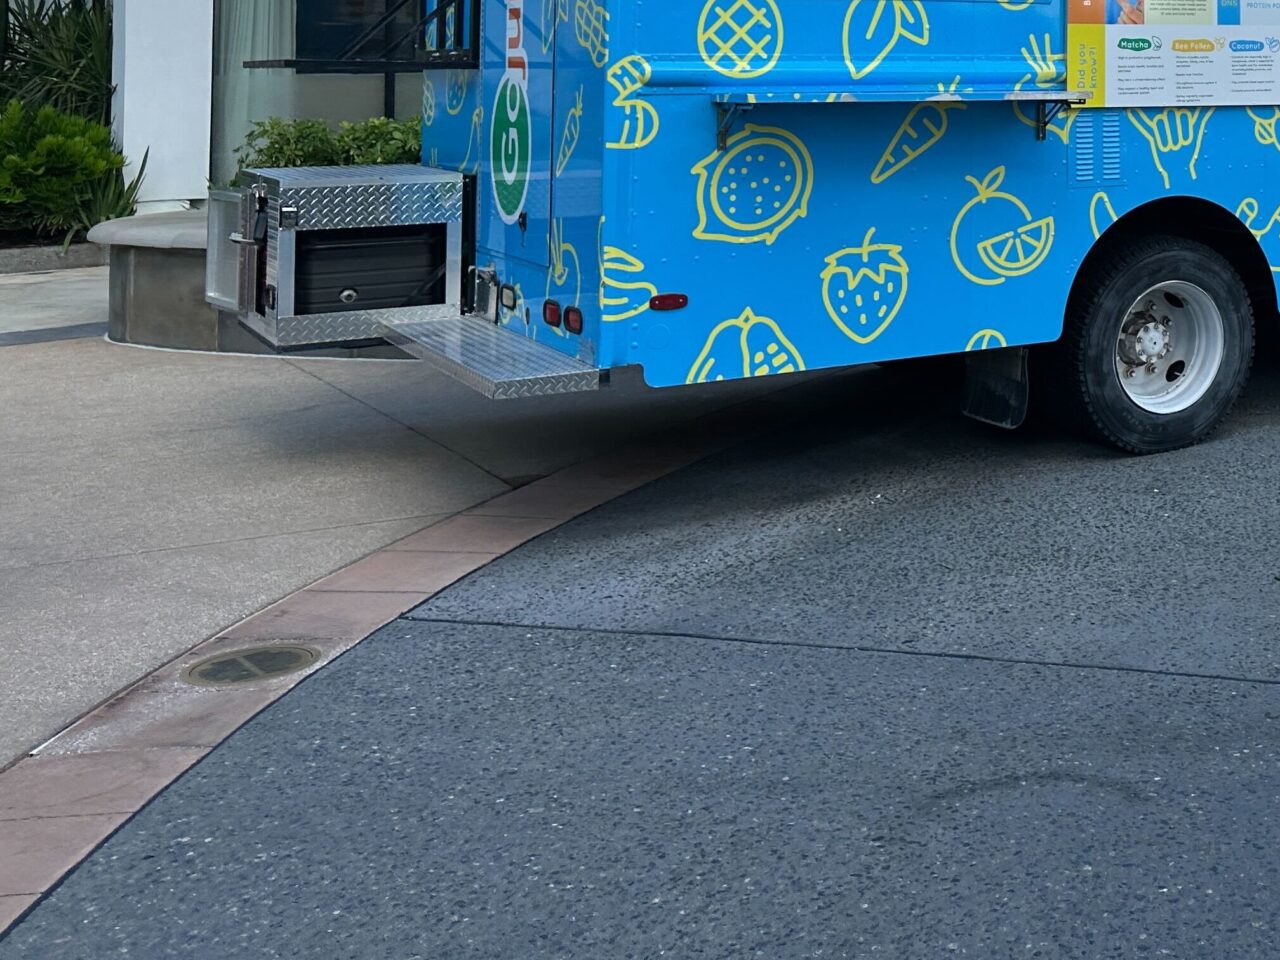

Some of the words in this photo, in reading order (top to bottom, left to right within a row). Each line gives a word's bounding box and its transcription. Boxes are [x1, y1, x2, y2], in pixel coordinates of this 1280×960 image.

[1121, 41, 1149, 49] Matcha
[1175, 42, 1189, 50] Bee
[1231, 41, 1261, 50] Coconut
[1079, 43, 1088, 65] you
[1077, 69, 1086, 89] Did
